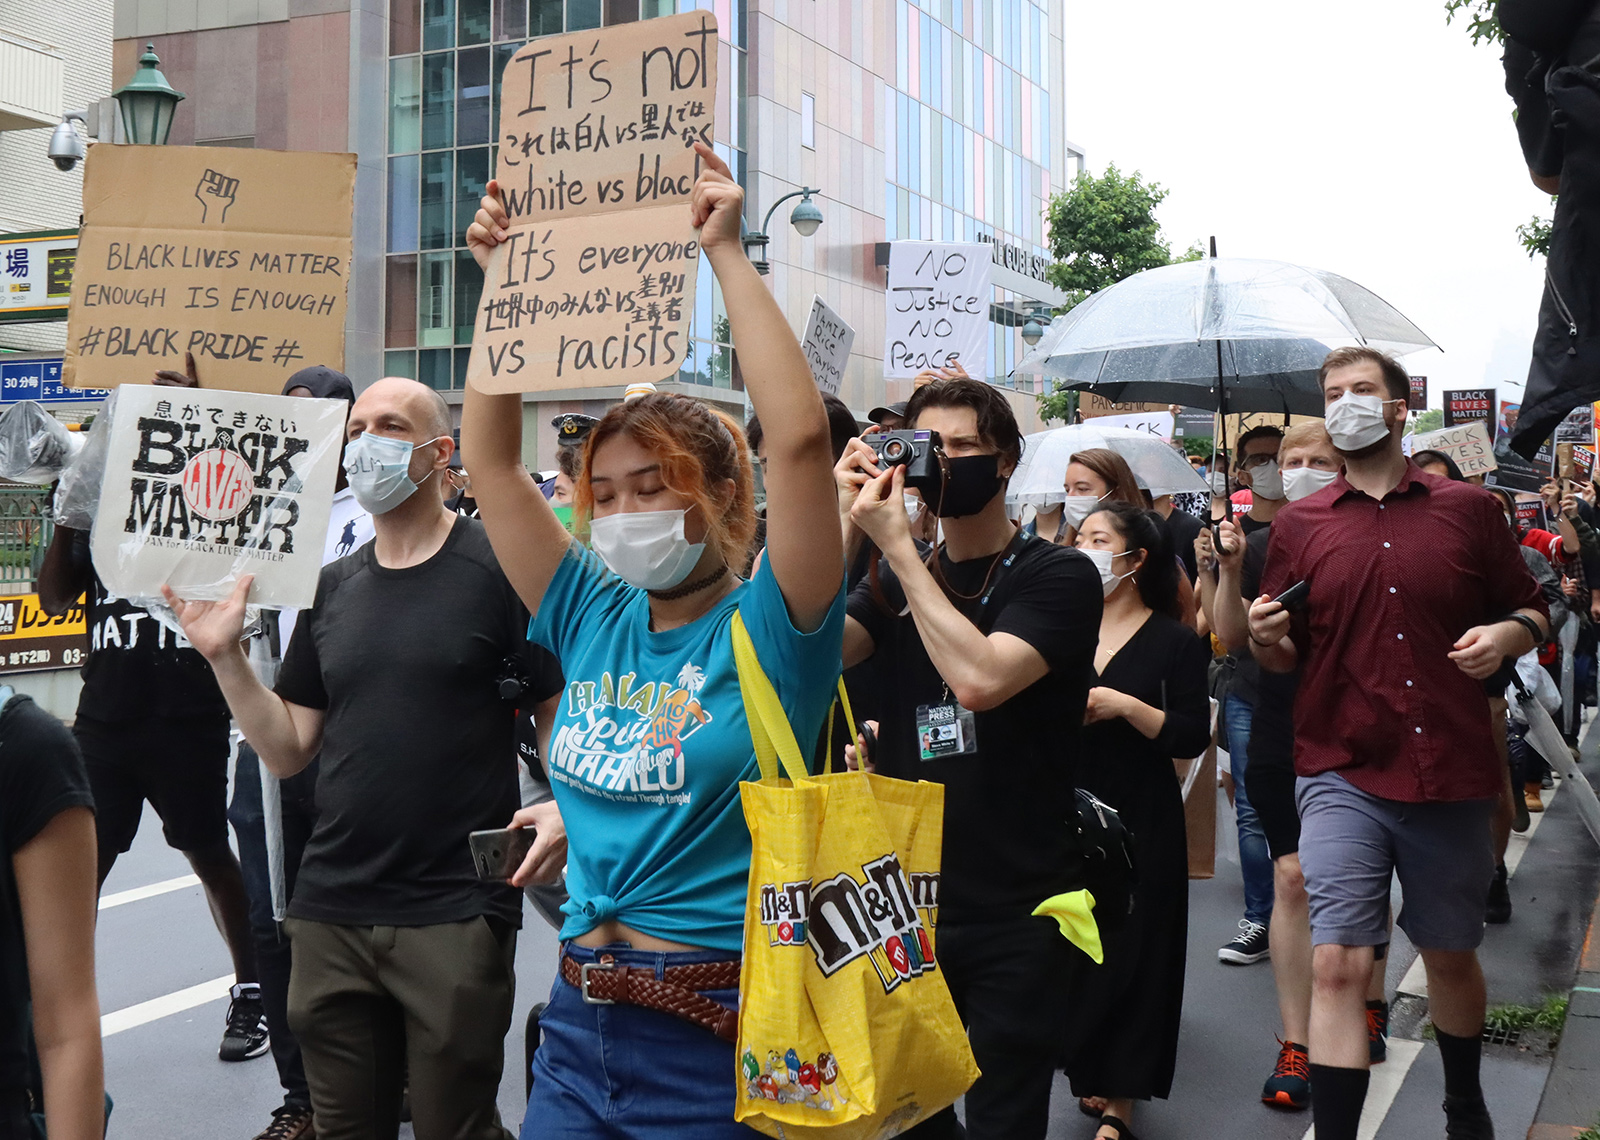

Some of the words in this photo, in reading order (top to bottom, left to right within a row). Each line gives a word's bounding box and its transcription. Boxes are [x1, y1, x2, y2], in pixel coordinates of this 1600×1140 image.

[515, 39, 612, 117] It's
[641, 16, 718, 97] not
[501, 163, 587, 218] white
[597, 179, 625, 204] vs
[107, 242, 175, 271] BLACK
[181, 245, 241, 270] LIVES
[249, 252, 342, 277] MATTER
[500, 229, 556, 290] It's
[578, 240, 698, 275] everyone
[915, 249, 967, 282] NO
[977, 232, 1004, 267] NE
[1004, 243, 1032, 278] CUBE
[84, 284, 166, 309] ENOUGH
[184, 286, 221, 309] IS
[231, 287, 337, 316] ENOUGH
[891, 286, 982, 315] Justice
[813, 324, 836, 357] Rice
[908, 317, 954, 339] NO
[187, 329, 269, 363] PRIDE
[272, 338, 304, 368] #
[488, 339, 526, 378] vs
[556, 322, 680, 378] racists
[890, 340, 961, 371] Peace
[809, 363, 837, 394] artin
[1451, 391, 1487, 401] BLACK
[1452, 401, 1488, 410] LIVES
[154, 400, 298, 434] 息ができない
[1452, 409, 1488, 418] MATTER
[1124, 422, 1163, 437] CK
[1421, 428, 1480, 450] LACK
[132, 416, 309, 494] BLACK
[1443, 442, 1484, 458] VES
[1459, 458, 1489, 472] TER
[1534, 453, 1552, 464] ATTER
[183, 449, 254, 519] LIVES
[124, 477, 300, 554] MATTER
[1516, 502, 1541, 511] EATHE
[132, 534, 164, 548] PAN
[166, 540, 181, 549] for
[183, 541, 215, 554] BLACK
[217, 545, 244, 557] LIVES
[247, 549, 285, 563] MATTER
[0, 603, 15, 625] 24
[928, 711, 955, 721] PRESS
